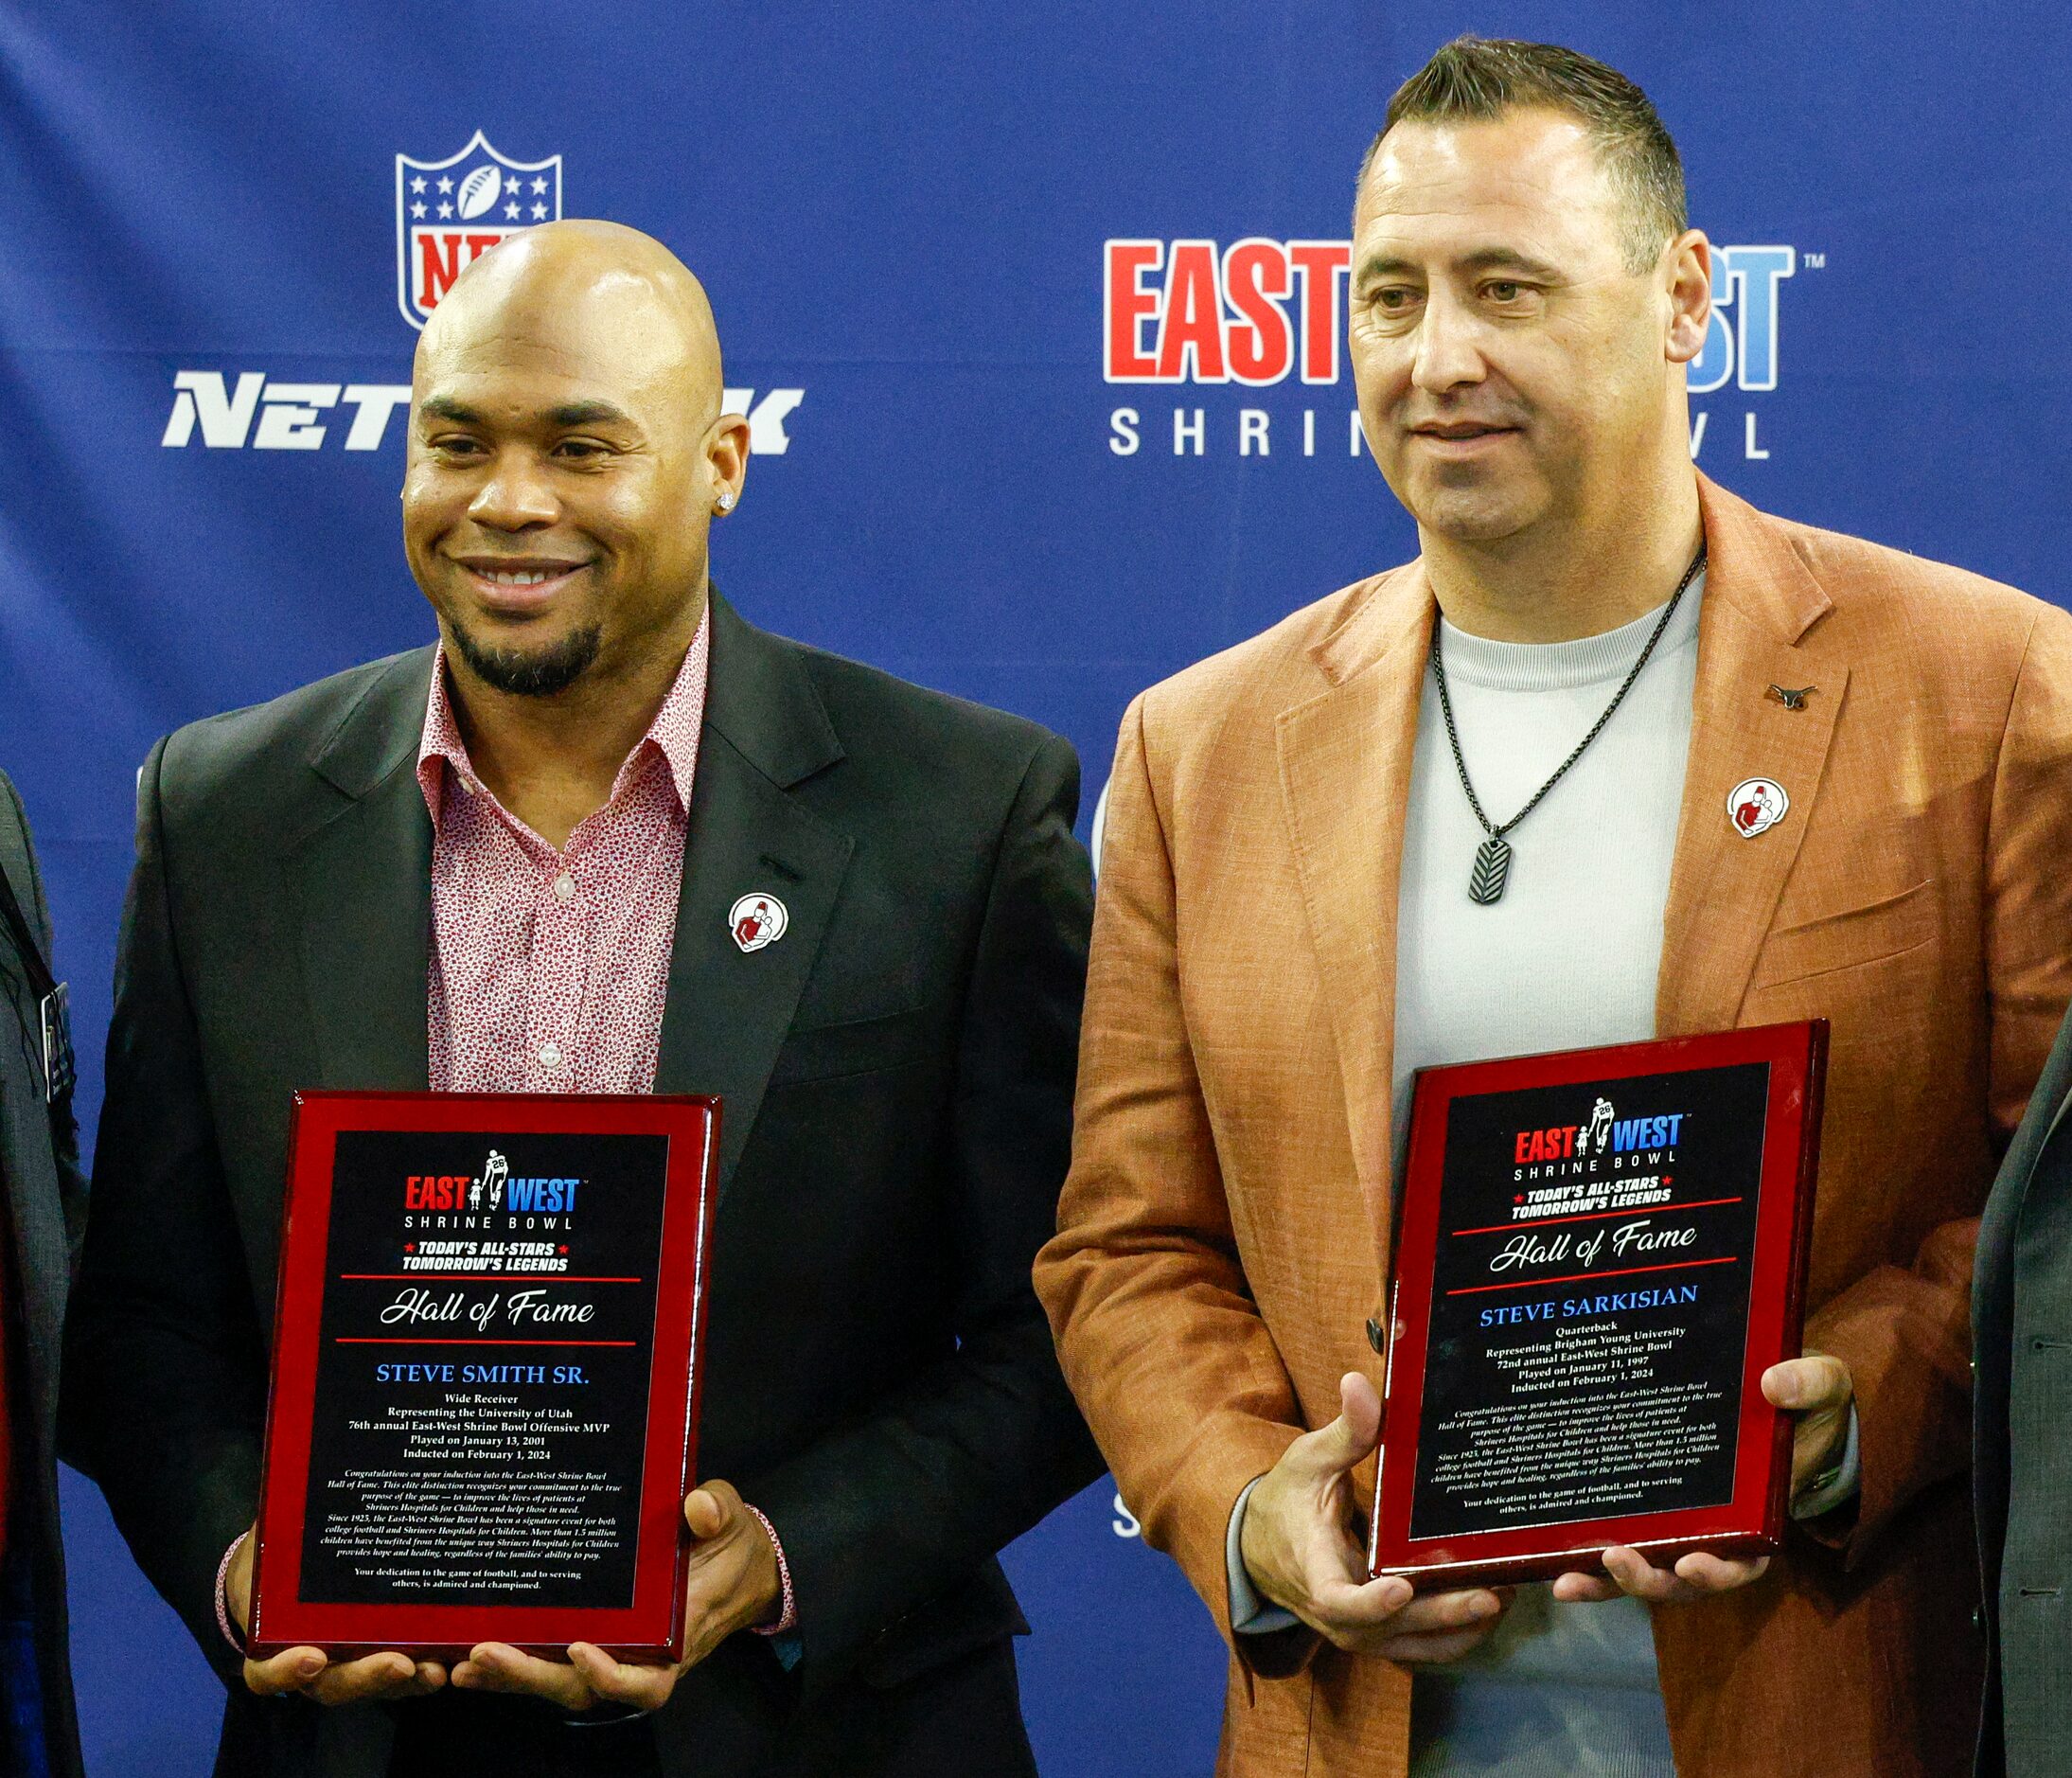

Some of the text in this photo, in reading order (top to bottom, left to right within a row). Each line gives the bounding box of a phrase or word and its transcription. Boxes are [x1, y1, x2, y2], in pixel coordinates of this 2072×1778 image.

[1803, 254, 1825, 269] TM
[1104, 238, 1353, 386] EAST
[161, 371, 806, 454] NETK
[1109, 408, 1372, 456] SHRI
[1599, 1105, 1610, 1115] 26
[1515, 1113, 1683, 1164] EAST WEST
[491, 1158, 505, 1169] 26
[1514, 1150, 1675, 1182] SHRINE BOWL
[405, 1176, 580, 1212] EAST WEST
[1527, 1175, 1659, 1204] TODAY'S ALL-STARS
[1512, 1187, 1673, 1220] TOMORROW'S LEGENDS
[404, 1216, 572, 1230] SHRINE BOWL
[418, 1240, 556, 1256] TODAY'S ALL-STARS
[1489, 1218, 1697, 1272] Hall of Fame
[402, 1256, 569, 1272] TOMORROW'S LEGENDS
[380, 1288, 595, 1332] Hall of Fame
[1479, 1285, 1698, 1327] STEVE SARKISIAN
[1555, 1321, 1618, 1338] Quarterback
[1486, 1326, 1686, 1359] Representing Brigham Young University
[1496, 1340, 1673, 1370] 72nd annual East-West Shrine Bowl
[376, 1363, 590, 1384] STEVE SMITH SR.
[1518, 1356, 1650, 1380] Played on January 11, 1997
[1511, 1368, 1654, 1394] Inducted on February 1, 2024
[445, 1394, 519, 1404] Wide Receiver
[387, 1407, 573, 1421] Representing the University of Utah
[348, 1420, 611, 1433] 76th annual East-West Shrine Bowl Offensive MVP
[410, 1434, 445, 1448] Played
[462, 1435, 504, 1449] January
[506, 1436, 520, 1447] 13,
[522, 1436, 545, 1446] 2001
[403, 1448, 450, 1459] Inducted
[467, 1449, 514, 1462] February
[517, 1450, 524, 1461] 1,
[527, 1449, 551, 1460] 2024
[345, 1469, 409, 1480] Congratulations
[443, 1470, 482, 1479] induction
[483, 1470, 500, 1479] into
[501, 1470, 515, 1479] the
[516, 1471, 557, 1480] East-West
[557, 1471, 584, 1480] Shrine
[585, 1472, 607, 1481] Bowl
[364, 1502, 579, 1515] Shriners Hospitals for Children and help those in need.
[328, 1514, 349, 1522] Since
[350, 1514, 371, 1523] 1925,
[373, 1514, 386, 1522] the
[387, 1515, 428, 1523] East-West
[429, 1515, 455, 1523] Shrine
[456, 1515, 479, 1523] Bowl
[479, 1516, 494, 1524] has
[495, 1516, 514, 1524] been
[522, 1516, 560, 1526] signature
[584, 1517, 597, 1526] for
[597, 1517, 616, 1525] both
[354, 1568, 375, 1576] Your
[376, 1568, 420, 1576] dedication
[433, 1568, 447, 1577] the
[472, 1569, 483, 1577] of
[484, 1569, 519, 1578] football,
[521, 1570, 538, 1578] and
[549, 1571, 582, 1580] serving
[392, 1579, 541, 1591] others, is admired and championed.
